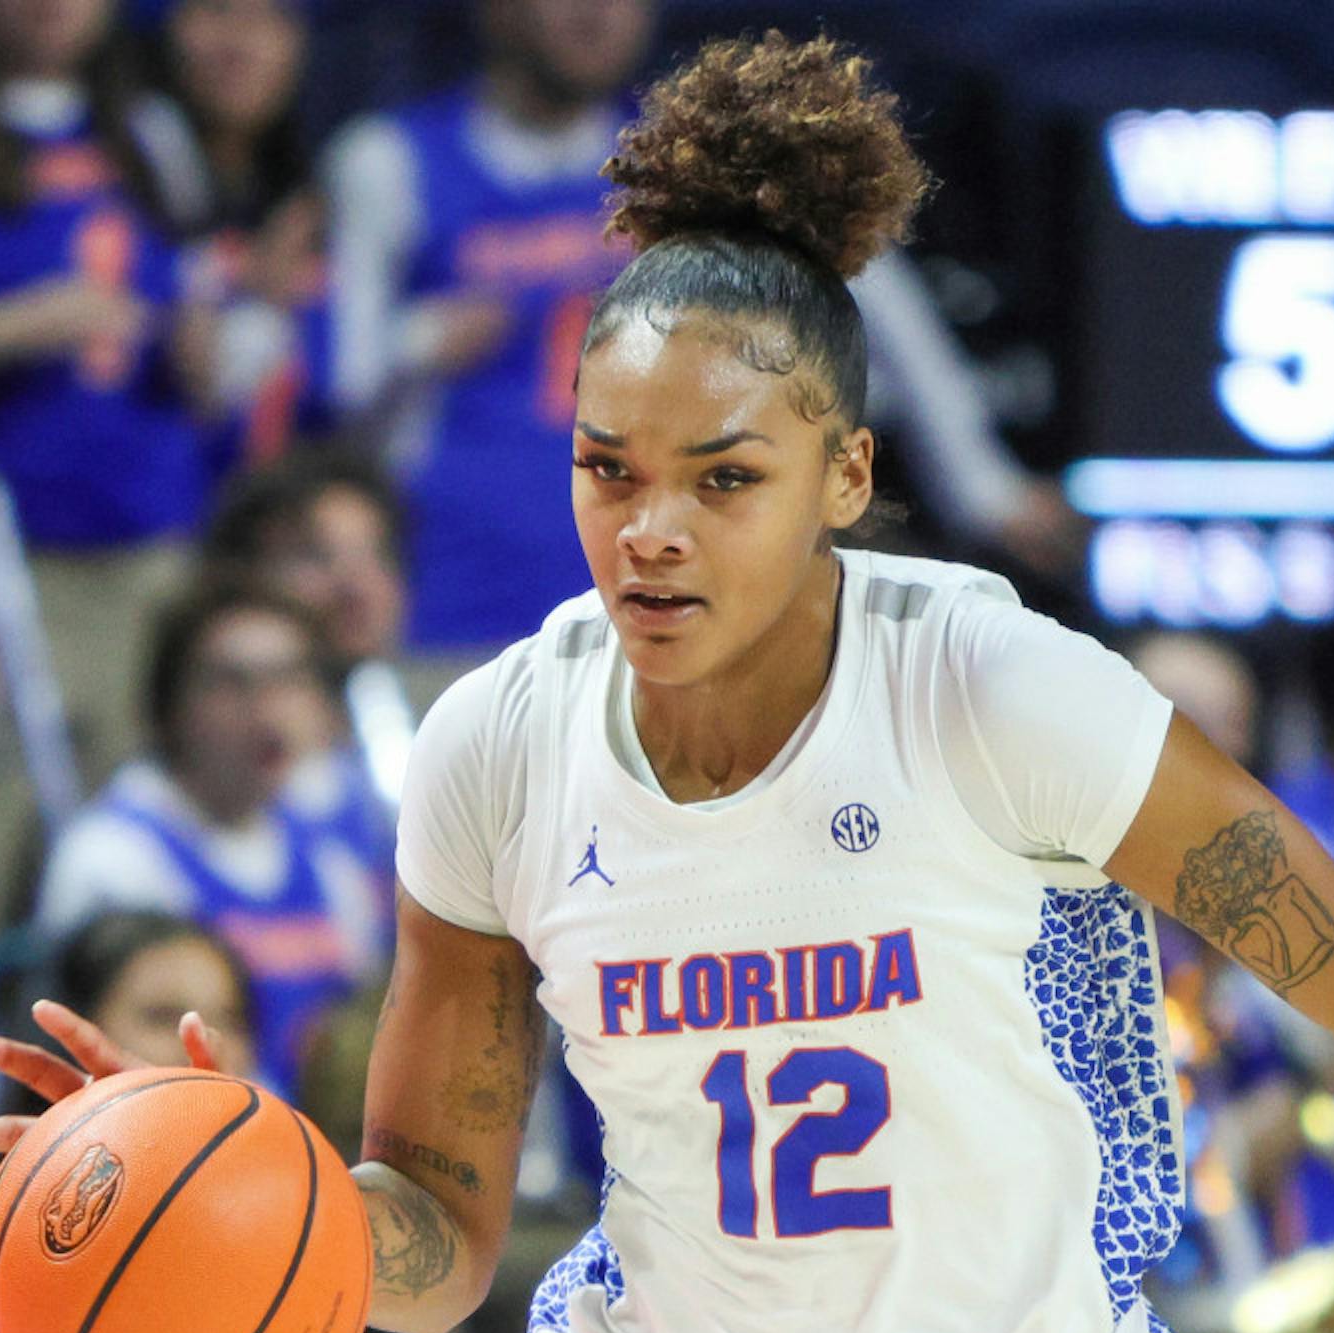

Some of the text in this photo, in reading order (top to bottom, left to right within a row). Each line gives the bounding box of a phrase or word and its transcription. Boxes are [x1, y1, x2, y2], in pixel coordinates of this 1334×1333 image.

[831, 803, 879, 852] SEC
[598, 928, 923, 1037] FLORIDA
[700, 1045, 894, 1240] 12
